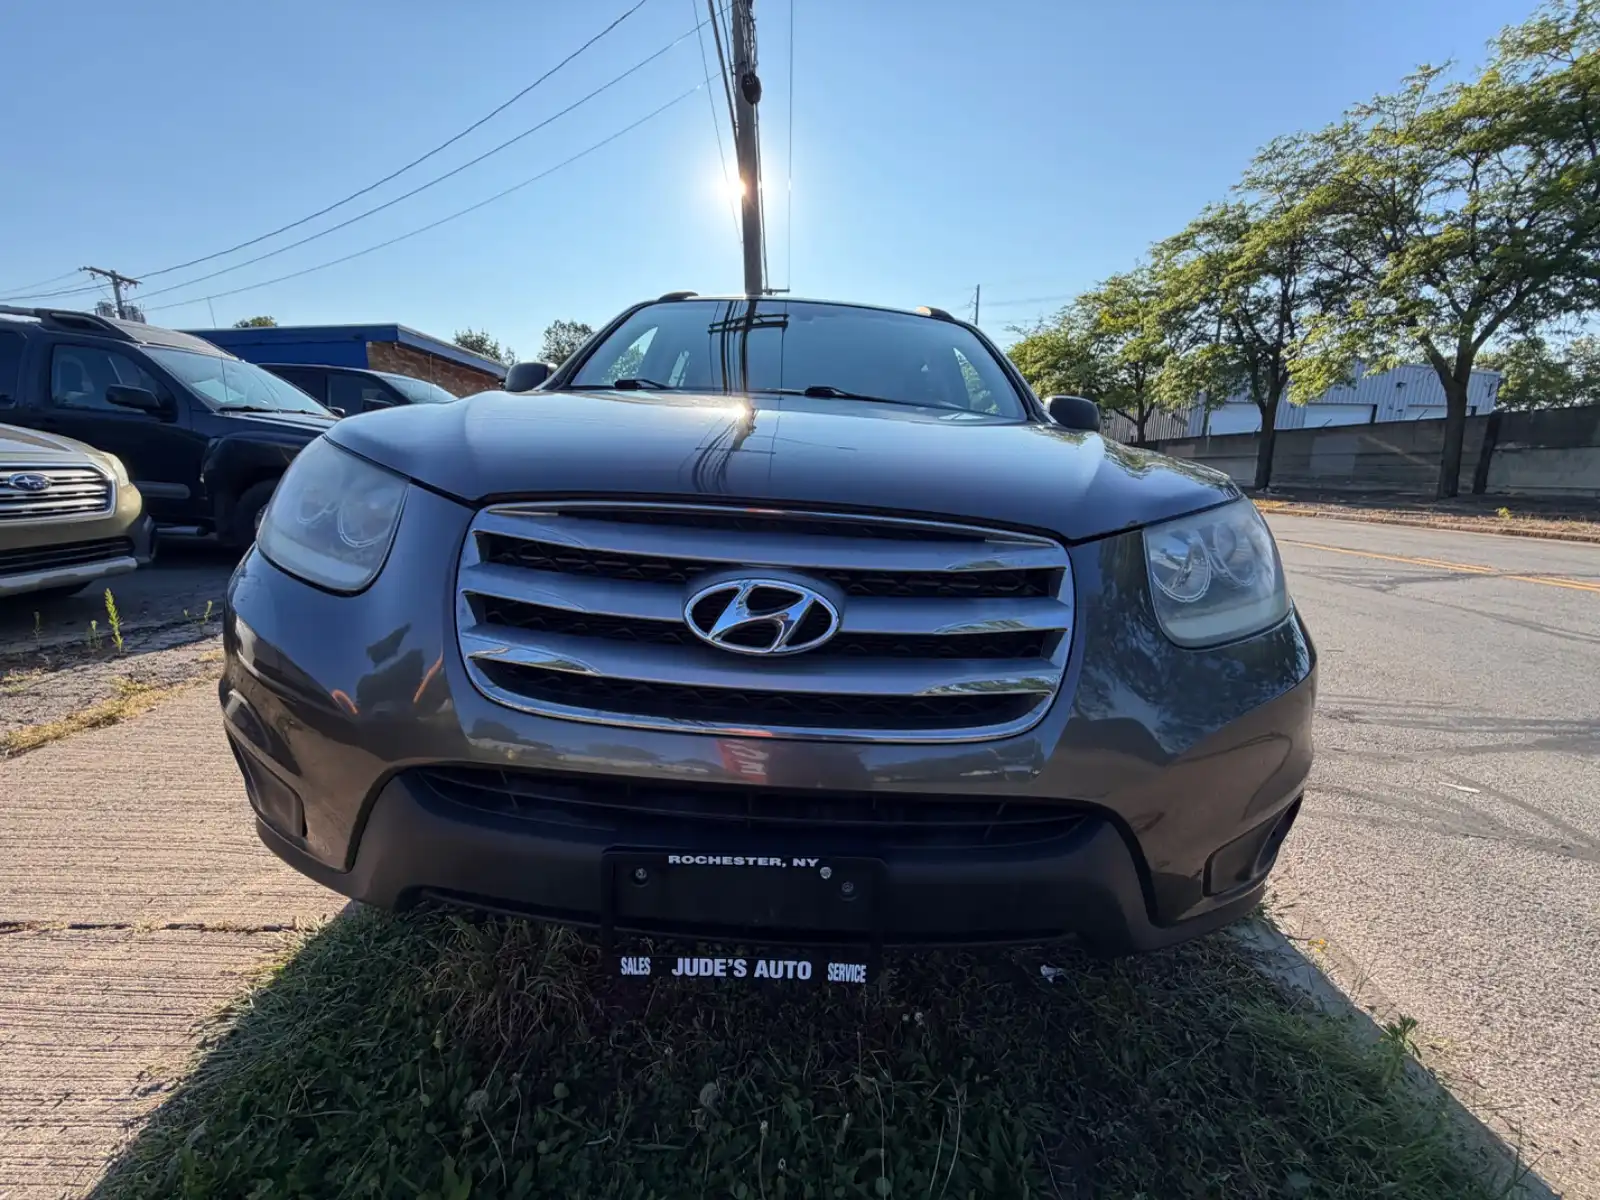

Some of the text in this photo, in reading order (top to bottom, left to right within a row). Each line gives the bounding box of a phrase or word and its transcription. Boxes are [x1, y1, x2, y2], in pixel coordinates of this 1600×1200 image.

[668, 855, 820, 868] ROCHESTER, NY
[620, 957, 867, 983] SALES JUDE'S AUTO SERVICE
